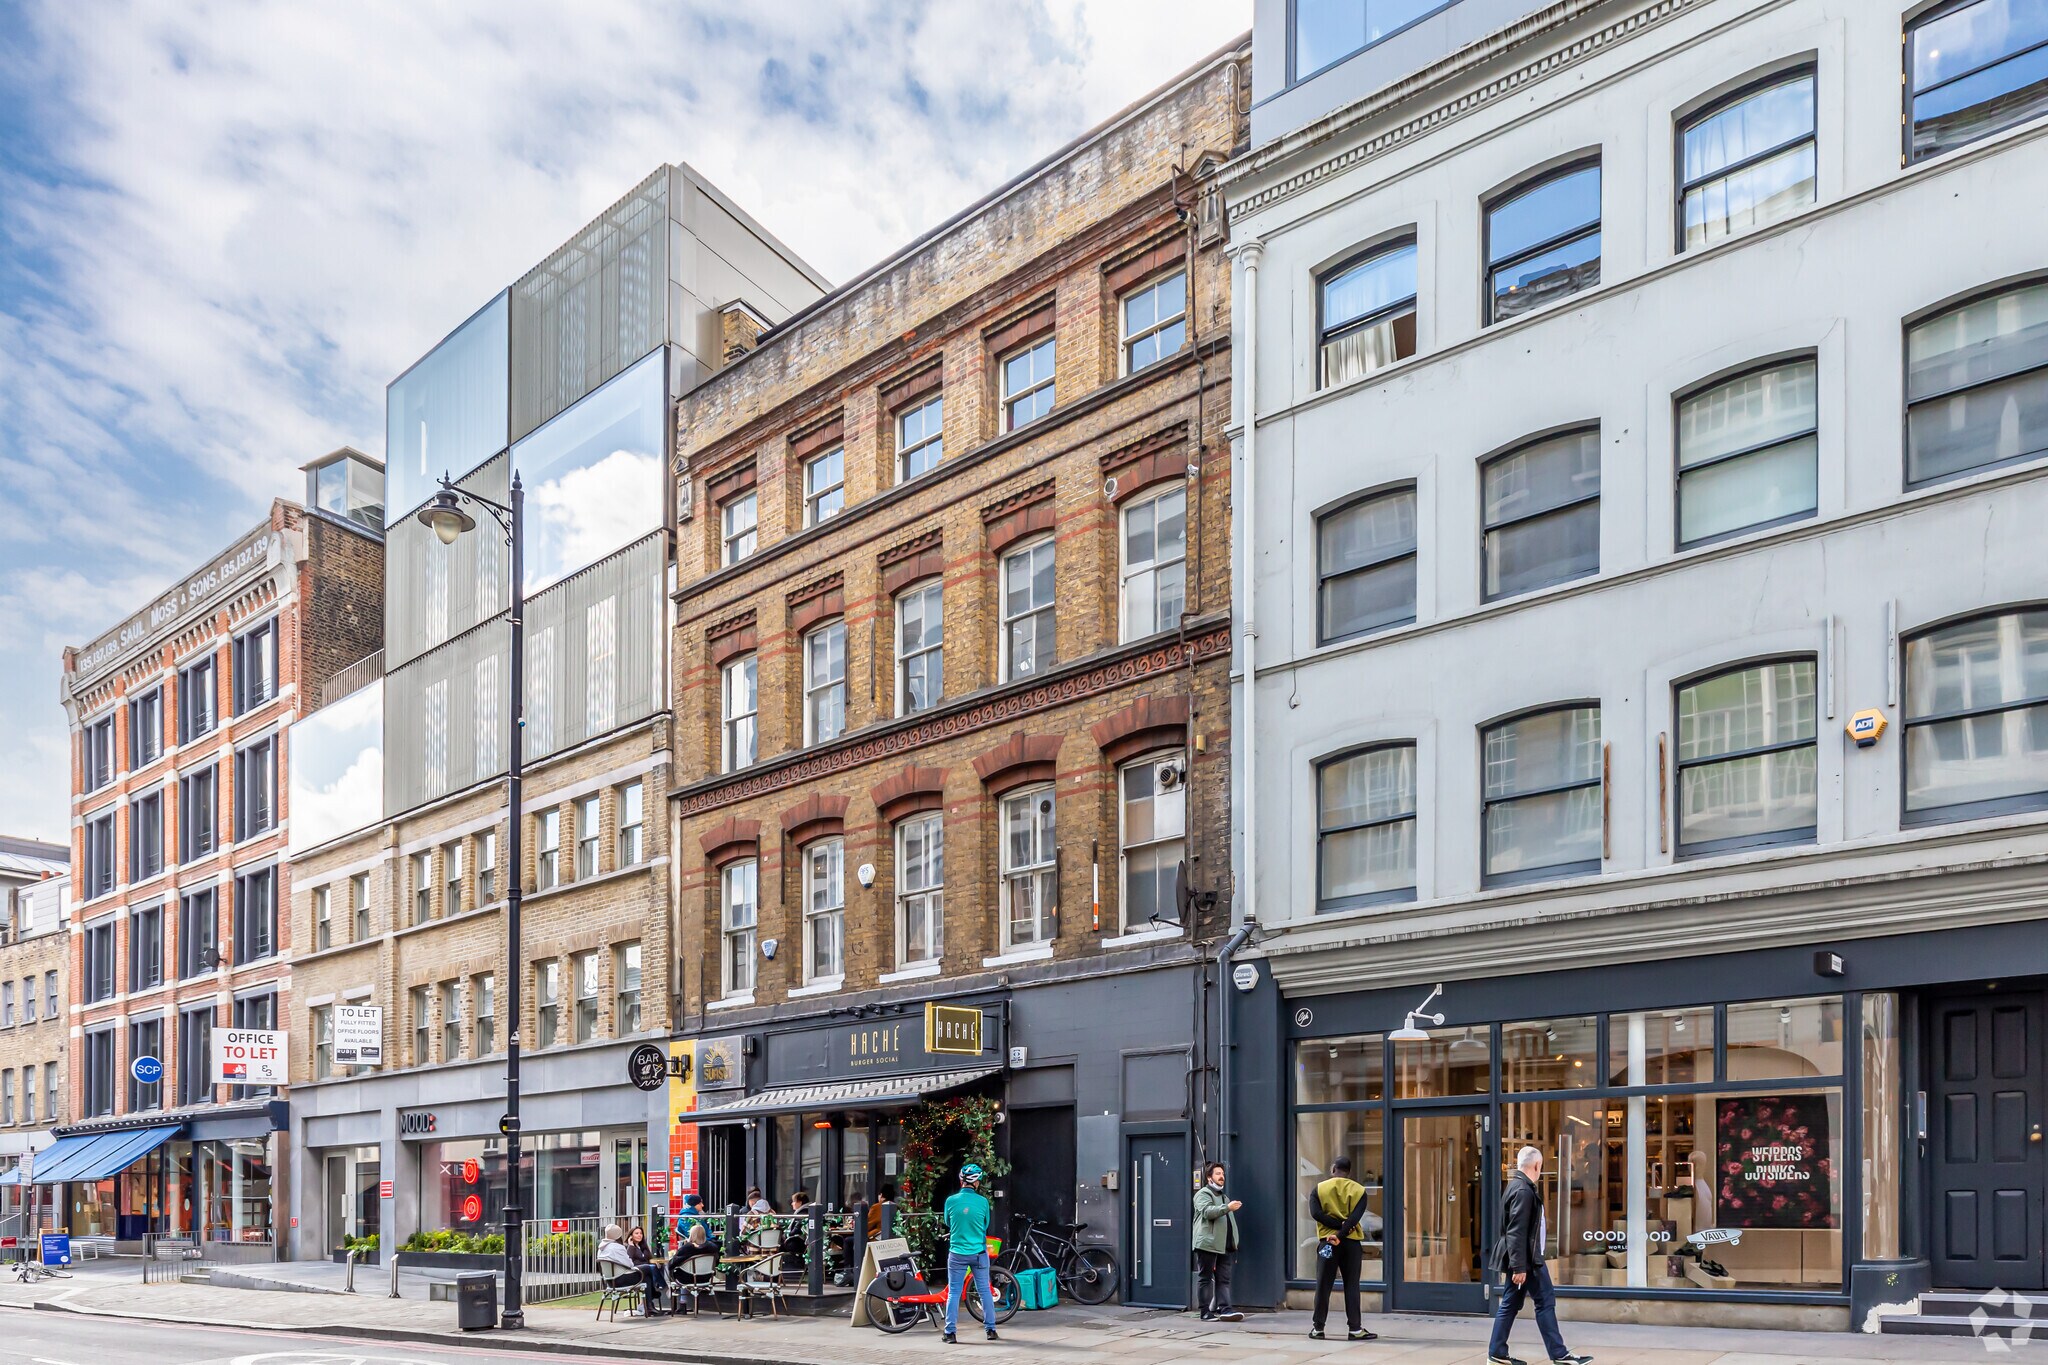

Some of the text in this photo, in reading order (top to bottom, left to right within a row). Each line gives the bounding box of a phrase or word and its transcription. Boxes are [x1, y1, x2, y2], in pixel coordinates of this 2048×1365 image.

[120, 621, 145, 647] SAUL
[150, 597, 178, 628] MOSS
[1855, 719, 1873, 730] ADT
[340, 1008, 377, 1018] TO LET
[934, 1021, 976, 1041] HACHÉ
[227, 1032, 274, 1045] OFFICE
[851, 1024, 900, 1056] HACHÉ
[223, 1045, 278, 1060] TO LET
[638, 1052, 660, 1065] BAR
[850, 1056, 899, 1067] BURGER SOCIAL
[136, 1064, 161, 1075] SCP
[1700, 1230, 1729, 1242] VAULT
